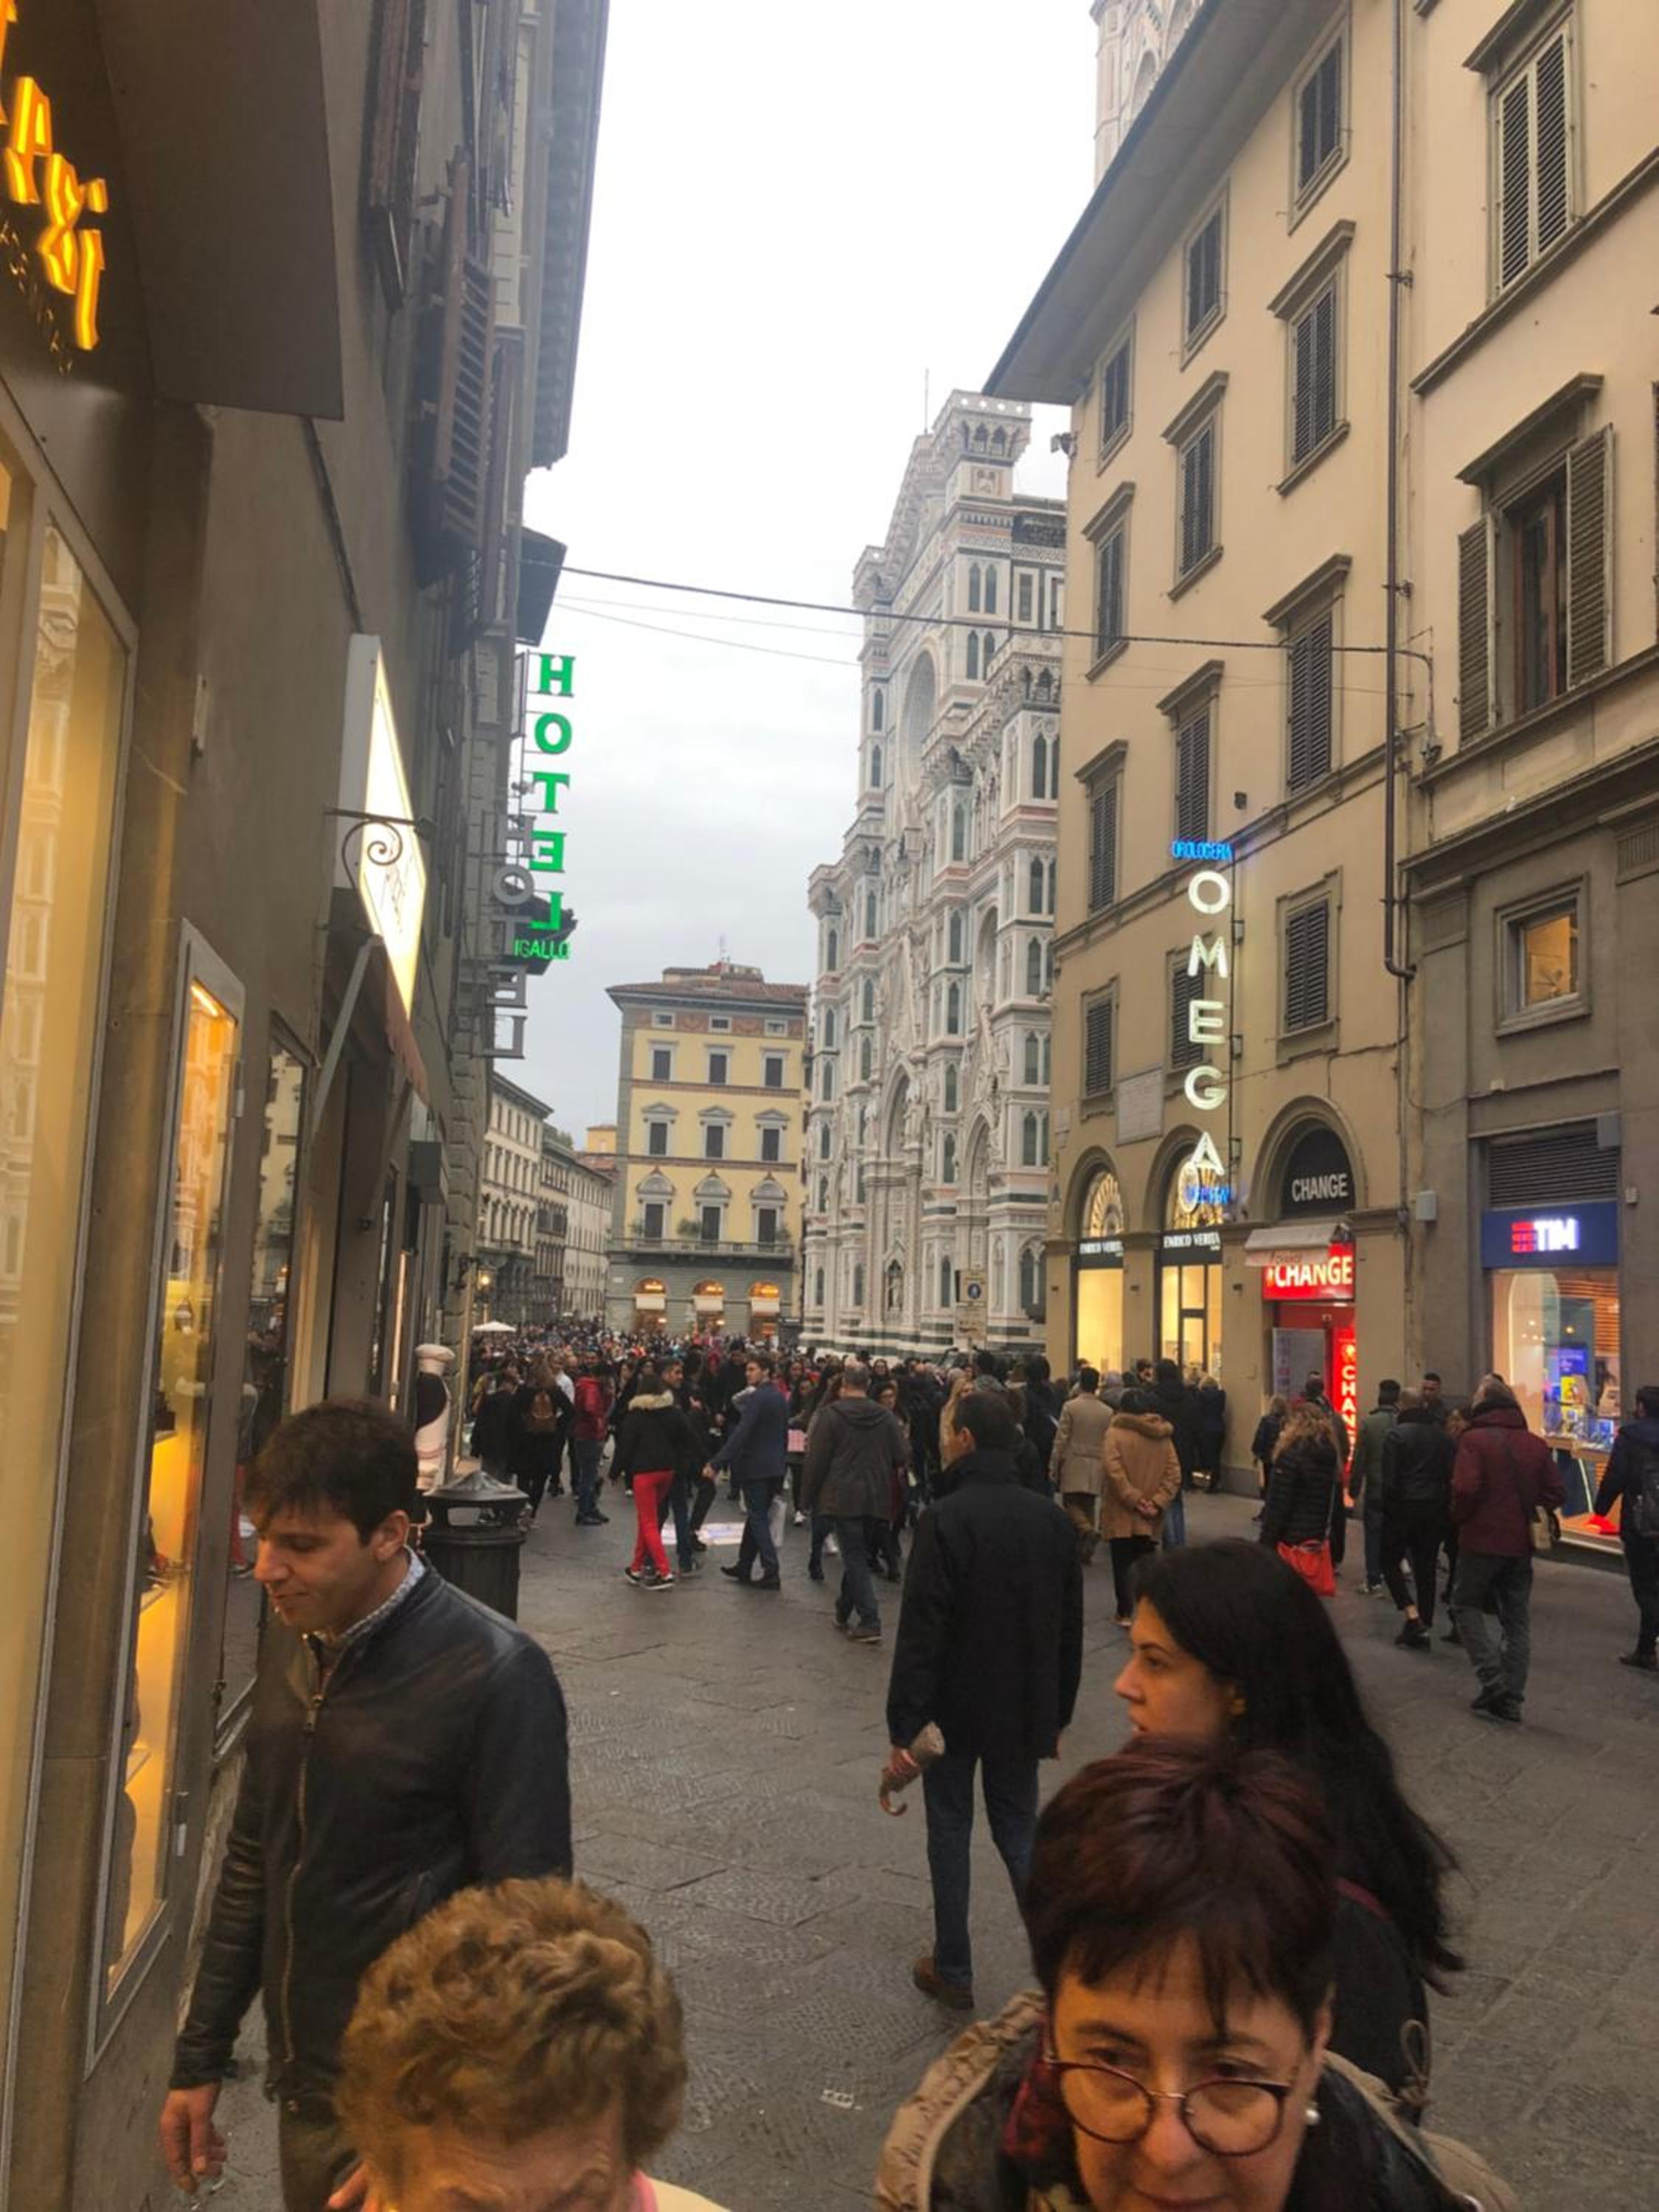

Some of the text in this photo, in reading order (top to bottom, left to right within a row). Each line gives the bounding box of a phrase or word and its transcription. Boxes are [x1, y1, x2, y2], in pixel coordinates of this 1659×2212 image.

[513, 939, 570, 961] IGALLO
[1184, 870, 1230, 1176] OMEGA
[1292, 1173, 1348, 1202] CHANGE
[1534, 1217, 1579, 1251] TIM
[1275, 1256, 1352, 1287] CHANGE
[1341, 1365, 1357, 1461] CHAN
